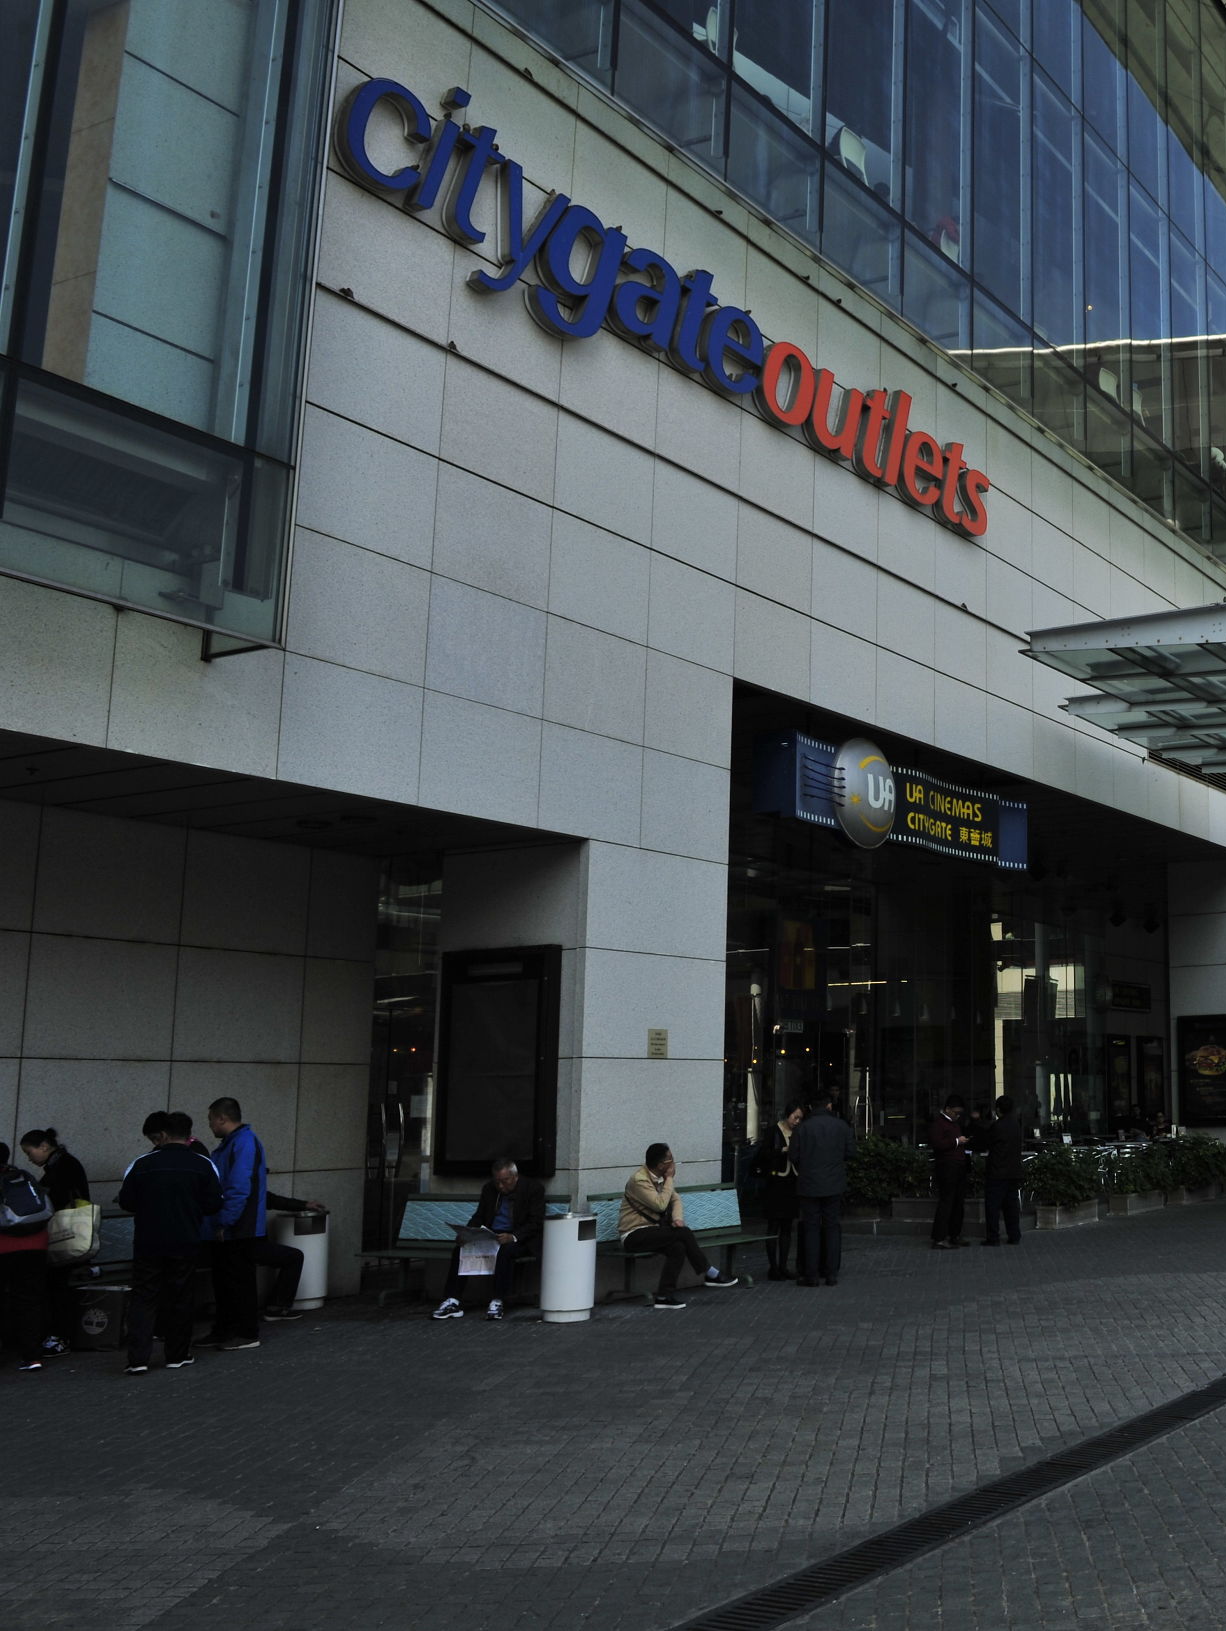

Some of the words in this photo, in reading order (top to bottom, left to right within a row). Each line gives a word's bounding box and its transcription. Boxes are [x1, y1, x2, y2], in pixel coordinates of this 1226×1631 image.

[867, 773, 894, 813] UA
[906, 782, 924, 804] UA
[929, 790, 982, 822] CINEMAS
[907, 811, 952, 840] CITYGATE
[959, 826, 993, 848] 東薈城
